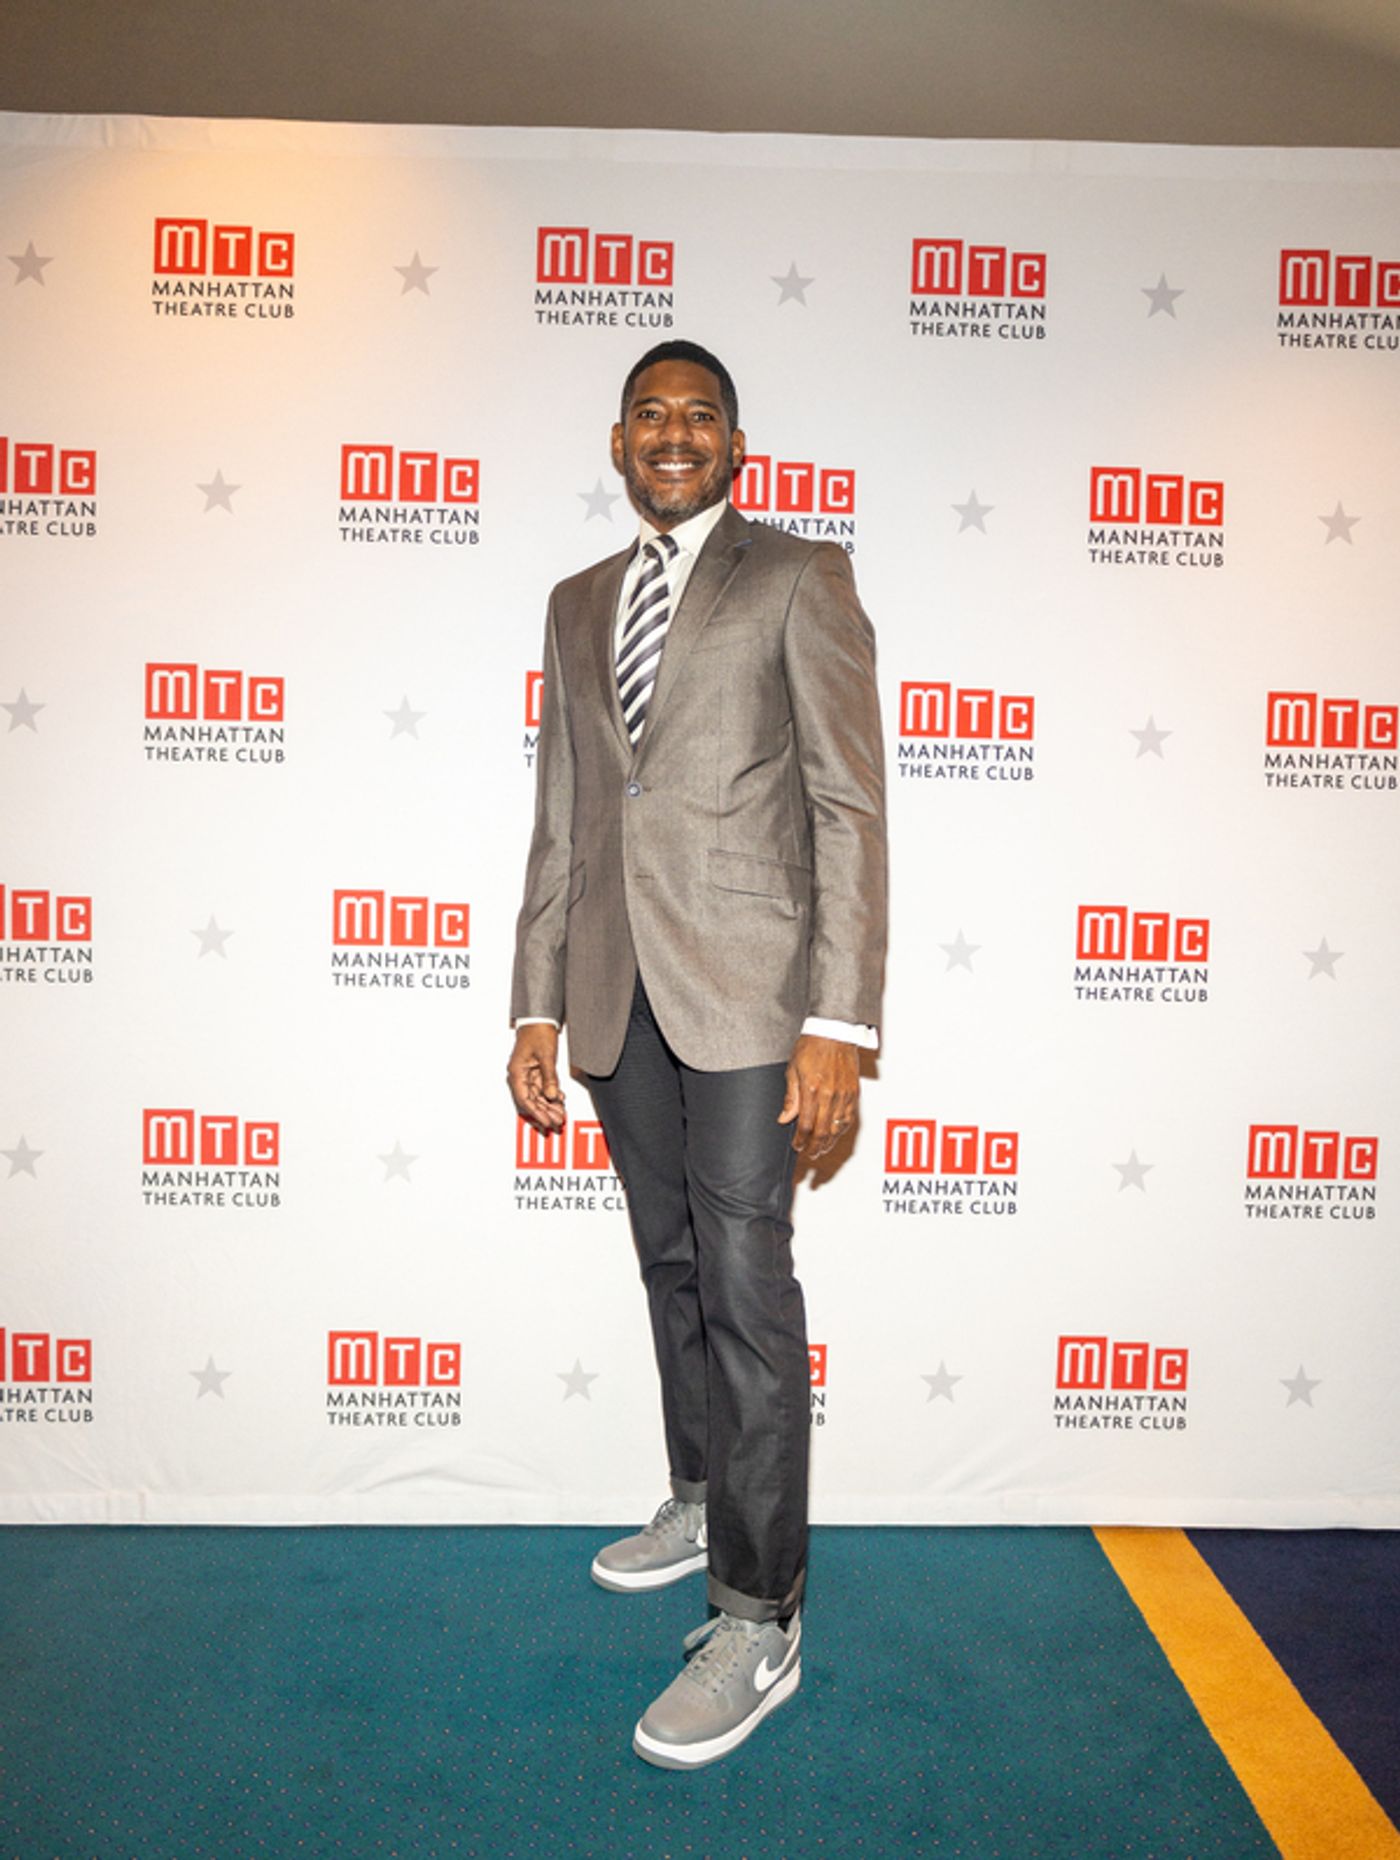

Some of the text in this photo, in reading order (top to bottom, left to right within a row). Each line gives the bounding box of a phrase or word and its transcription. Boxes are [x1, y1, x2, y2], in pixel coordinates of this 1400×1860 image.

[160, 224, 289, 271] MTC
[542, 233, 669, 281] MTC
[916, 244, 1041, 293] MTC
[151, 280, 294, 299] MANHATTAN
[534, 289, 674, 308] MANHATTAN
[152, 300, 294, 319] THEATRE CLUB
[909, 301, 1046, 321] MANHATTAN
[535, 310, 674, 328] THEATRE CLUB
[910, 321, 1046, 340] THEATRE CLUB
[1278, 332, 1400, 351] THEATRE CLU
[346, 450, 475, 498] MTC
[1095, 472, 1219, 521] MTC
[338, 506, 480, 525] MANHATTAN
[46, 520, 97, 537] CLUB
[339, 527, 480, 545] THEATRE CLUB
[1087, 528, 1224, 548] MANHATTAN
[1088, 548, 1224, 568] THEATRE CLUB
[150, 668, 280, 717] MTC
[904, 686, 1030, 735] MTC
[1271, 697, 1394, 744] MTC
[144, 725, 284, 743] MANHATTAN
[144, 746, 285, 763] THEATRE CLUB
[898, 743, 1033, 762] MANHATTAN
[1264, 753, 1398, 771] MANHATTAN
[898, 763, 1034, 781] THEATRE CLUB
[1265, 772, 1398, 790] THEATRE CLUB
[337, 894, 465, 943] MTC
[1081, 910, 1205, 957] MTC
[331, 952, 470, 969] MANHATTAN
[44, 968, 93, 984] CLUB
[332, 972, 470, 989] THEATRE CLUB
[1074, 966, 1208, 984] MANHATTAN
[1075, 986, 1208, 1003] THEATRE CLUB
[147, 1114, 275, 1162] MTC
[520, 1120, 605, 1165] MT
[889, 1124, 1014, 1170] MTC
[1252, 1130, 1374, 1175] MTC
[142, 1171, 280, 1188] MANHATTAN
[513, 1175, 626, 1192] MANHATT
[882, 1179, 1017, 1196] MANHATTAN
[143, 1191, 281, 1207] THEATRE CLUB
[1245, 1185, 1376, 1201] MANHATTAN
[515, 1196, 626, 1211] THEATRE CL
[883, 1199, 1017, 1215] THEATRE CLUB
[1245, 1204, 1376, 1220] THEATRE CLUB
[332, 1336, 457, 1382] MTC
[1061, 1341, 1184, 1386] MTC
[326, 1392, 461, 1407] MANHATTAN
[1054, 1395, 1187, 1412] MANHATTAN
[44, 1408, 94, 1423] CLUB
[327, 1411, 461, 1427] THEATRE CLUB
[1055, 1414, 1187, 1430] THEATRE CLUB
